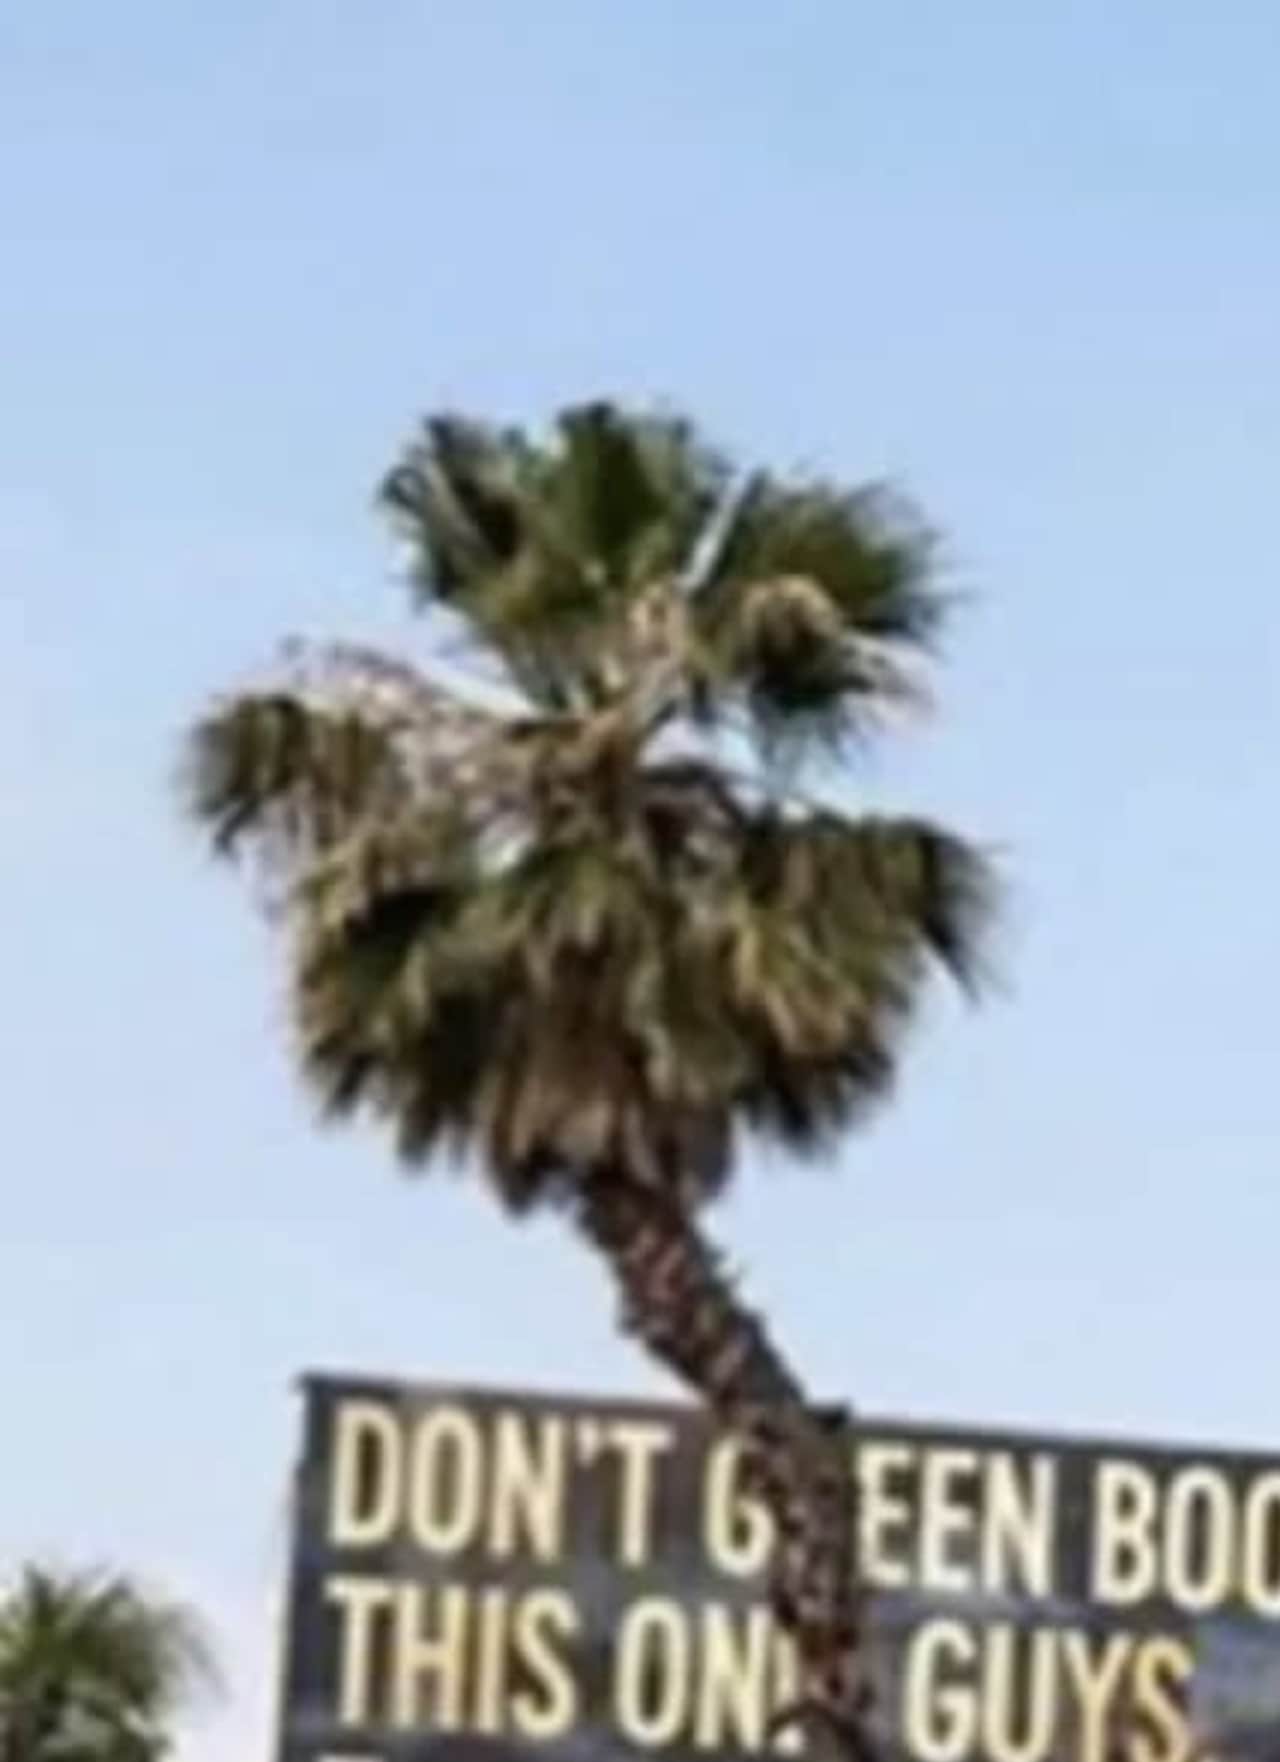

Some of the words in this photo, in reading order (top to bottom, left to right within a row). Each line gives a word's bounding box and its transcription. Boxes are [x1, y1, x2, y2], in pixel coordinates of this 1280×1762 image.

[325, 1402, 671, 1568] DON'T
[703, 1434, 1057, 1600] GEEN
[324, 1577, 582, 1740] THIS
